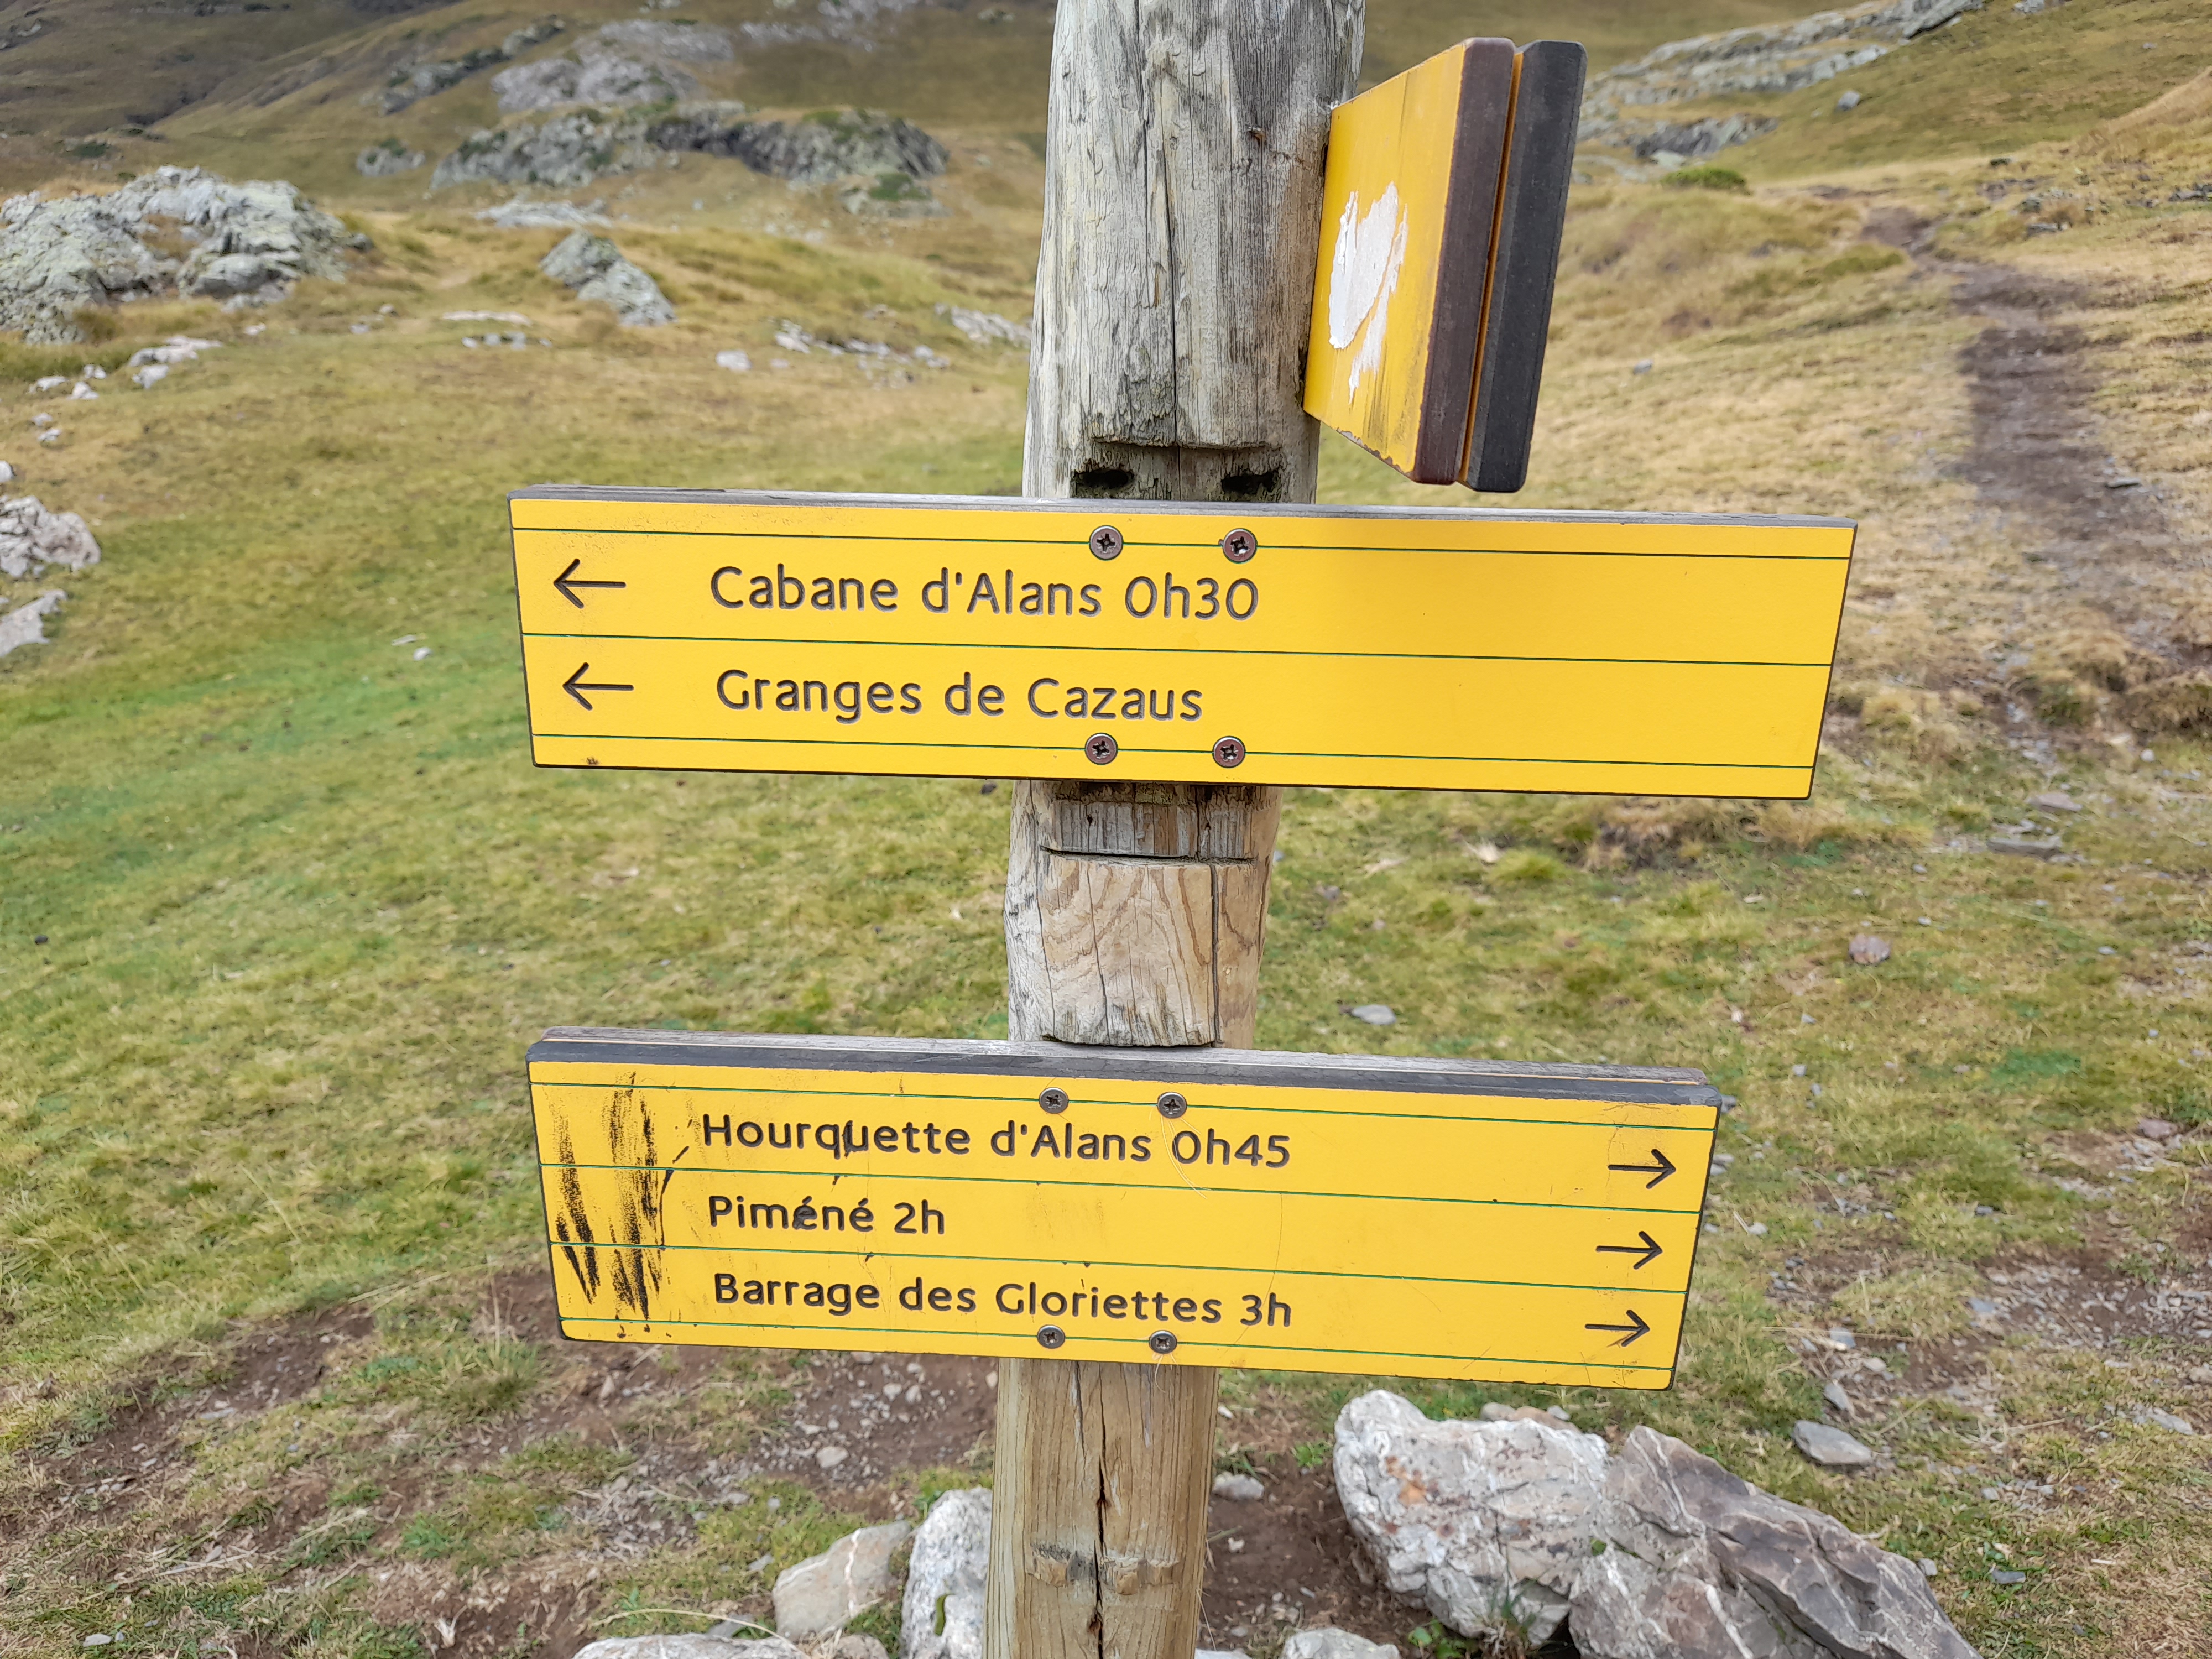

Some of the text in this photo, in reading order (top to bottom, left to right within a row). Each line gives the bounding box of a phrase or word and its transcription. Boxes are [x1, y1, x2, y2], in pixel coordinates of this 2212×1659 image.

[710, 562, 1259, 620] Cabane d'Alans 0h30
[716, 669, 1203, 724] Granges de Cazaus
[702, 1113, 1290, 1168] Hourquette d'Alans 0h45
[708, 1194, 945, 1235] Piméné 2h
[713, 1272, 1292, 1328] Barrage des Gloriettes 3h
